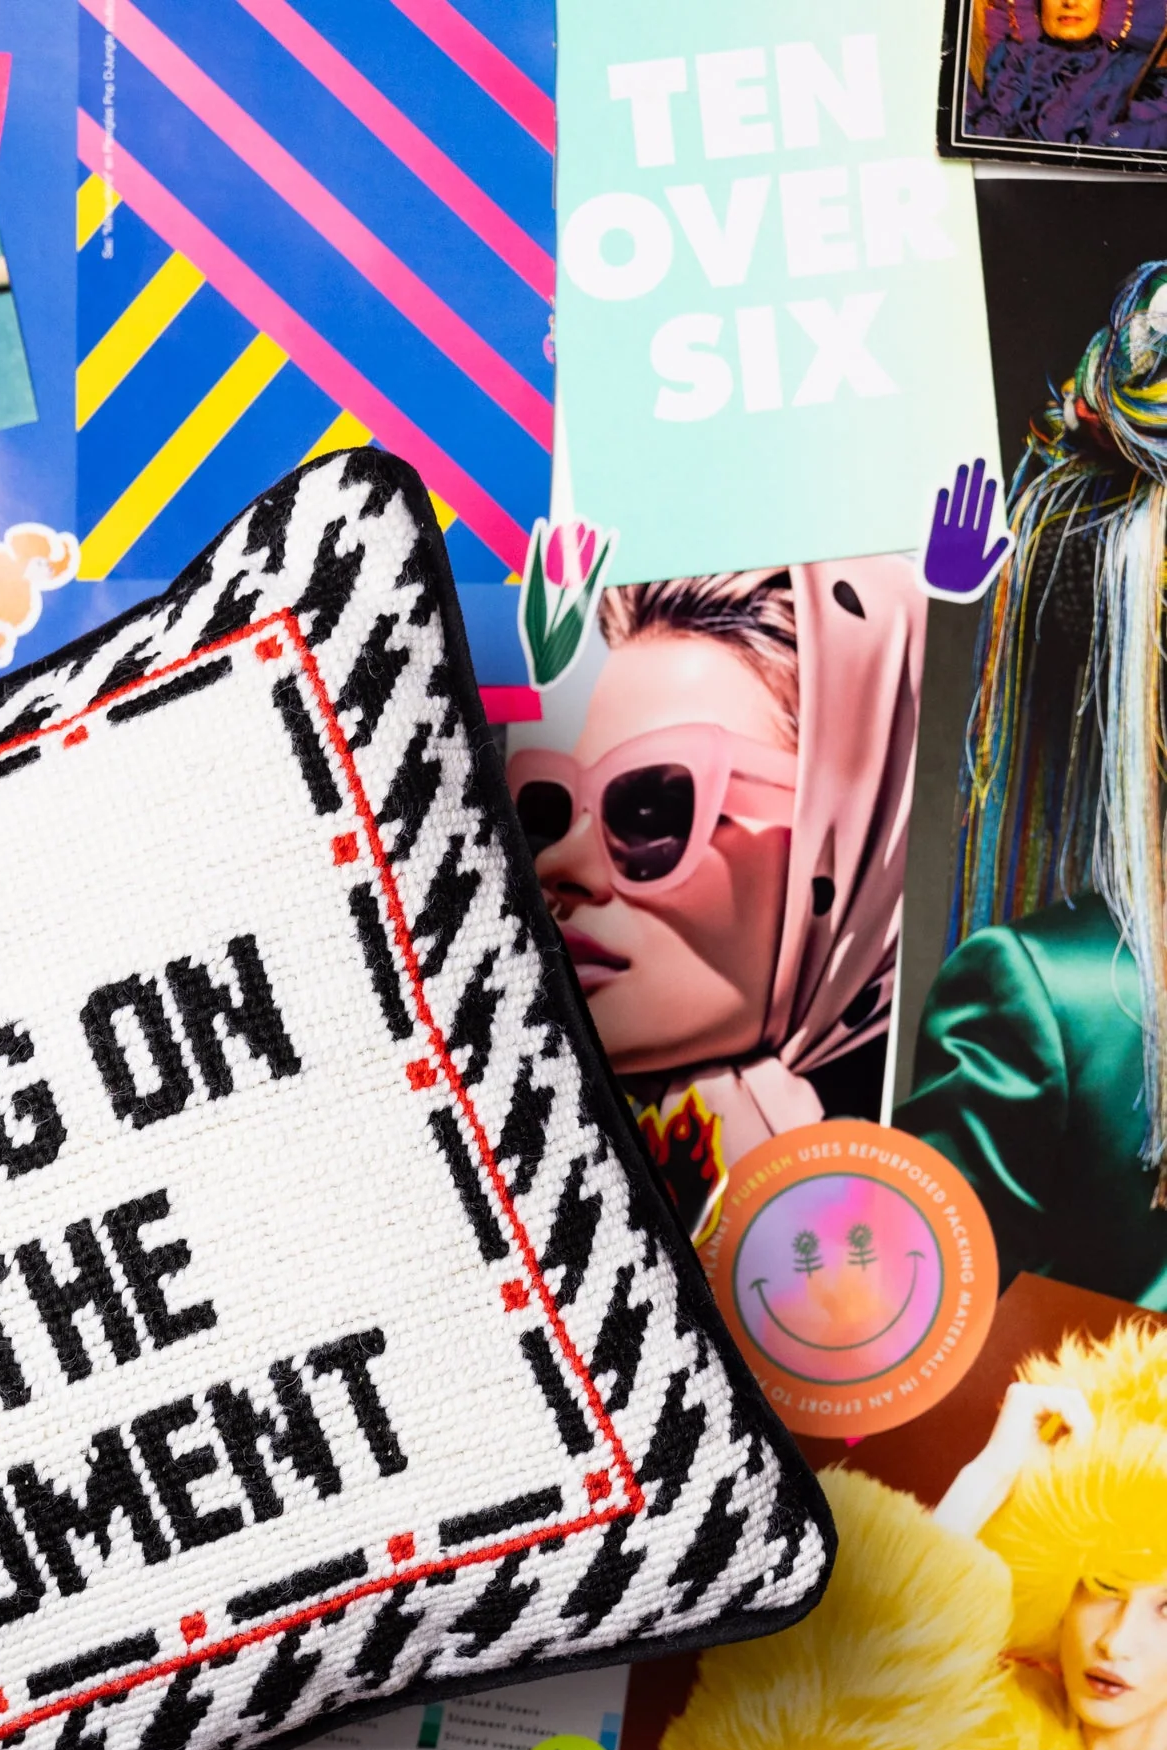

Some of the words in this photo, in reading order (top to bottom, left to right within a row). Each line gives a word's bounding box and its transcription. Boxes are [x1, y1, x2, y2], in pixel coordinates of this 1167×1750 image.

[608, 34, 886, 169] TEN
[562, 157, 957, 300] OVER
[650, 292, 899, 424] SIX
[80, 934, 302, 1129] ON
[731, 1155, 793, 1207] FURBISH
[798, 1142, 842, 1162] USES
[848, 1142, 946, 1204] REPURPOSED
[943, 1206, 974, 1284] PACKING
[919, 1291, 972, 1379] MATERIALS
[771, 1387, 792, 1406] TO
[798, 1397, 862, 1415] EFFORT
[868, 1391, 894, 1407] AN
[898, 1376, 919, 1395] IN
